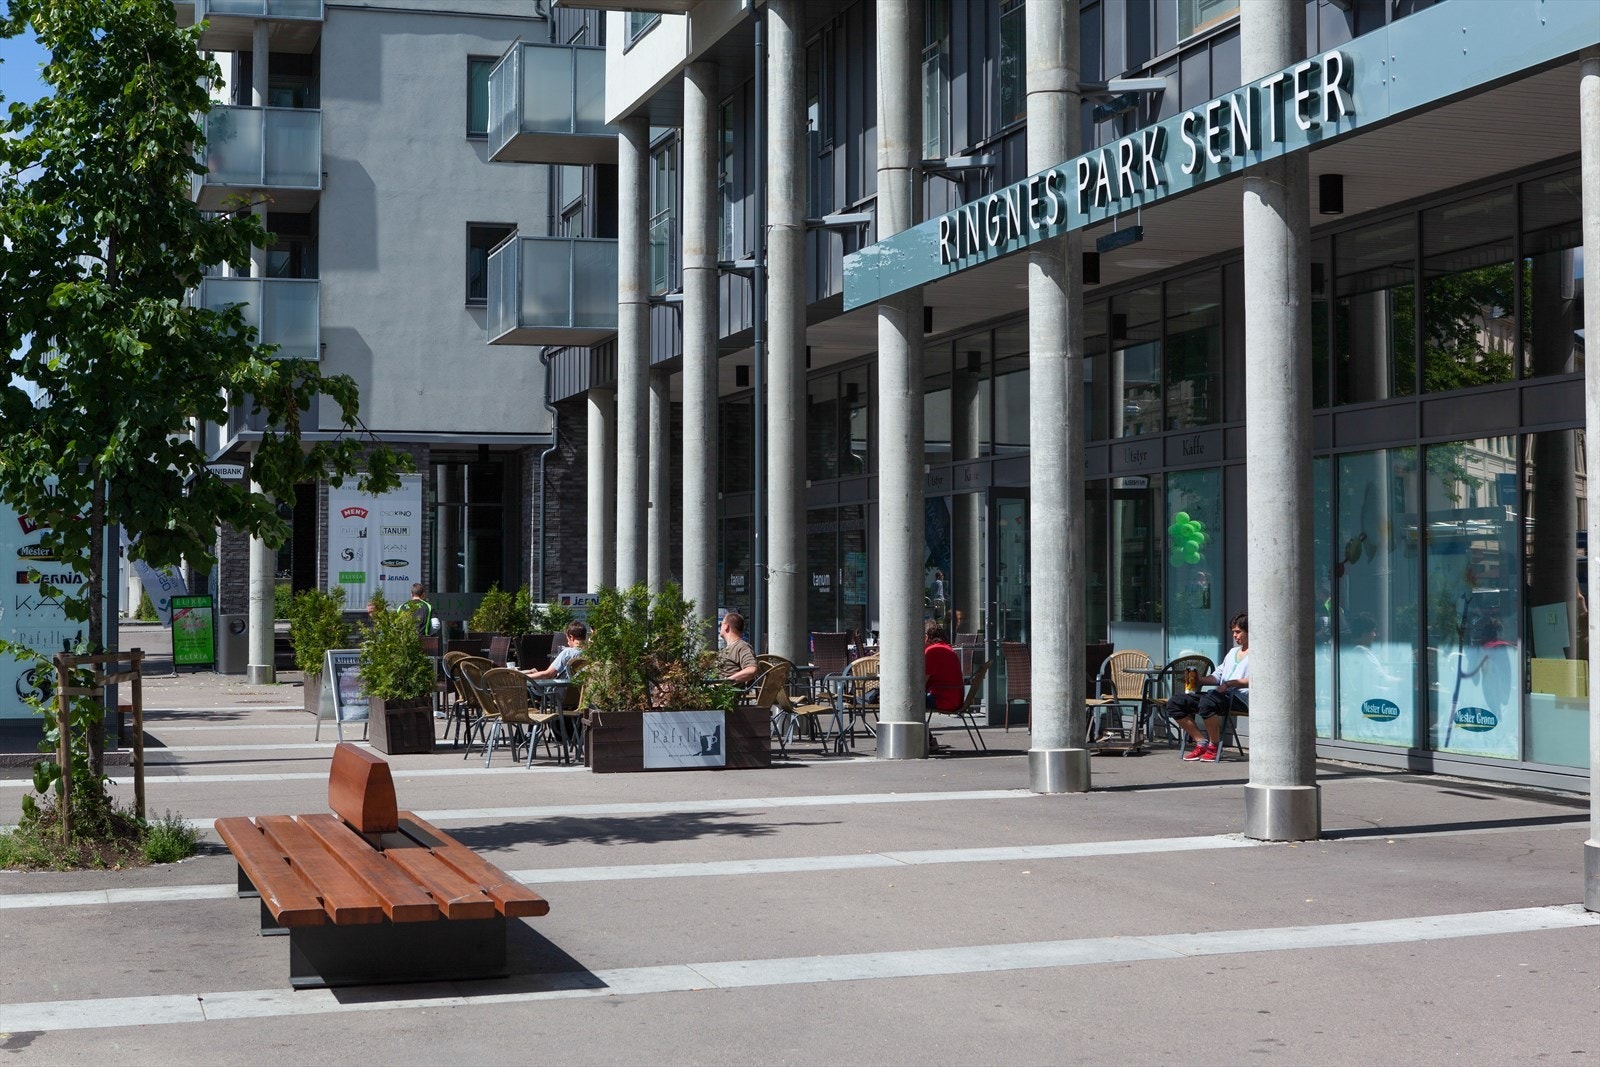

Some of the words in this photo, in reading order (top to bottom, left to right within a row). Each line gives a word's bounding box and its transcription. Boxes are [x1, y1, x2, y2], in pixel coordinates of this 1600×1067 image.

[940, 170, 1060, 266] RINGNES
[1077, 126, 1163, 214] PARK
[1181, 50, 1349, 174] SENTER
[1183, 435, 1204, 456] Kaffe
[344, 508, 366, 516] MENY
[21, 547, 50, 556] Mester
[812, 572, 831, 586] tanum
[1363, 701, 1380, 714] Mester
[1456, 710, 1475, 723] Mester
